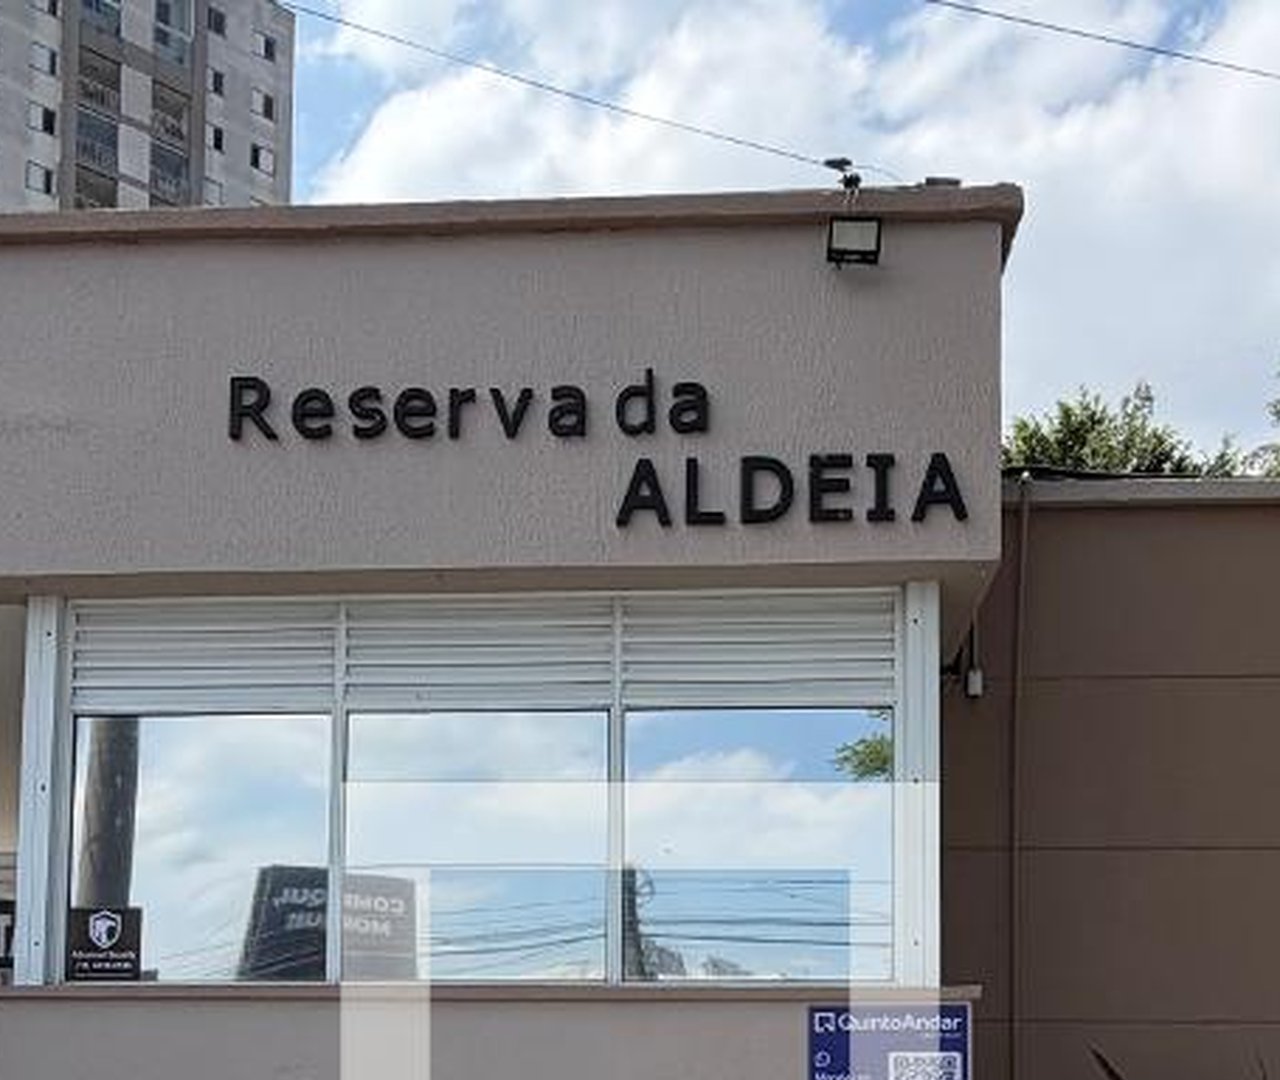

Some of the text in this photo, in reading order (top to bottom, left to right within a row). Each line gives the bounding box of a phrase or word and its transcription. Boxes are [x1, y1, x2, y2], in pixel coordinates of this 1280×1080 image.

[228, 368, 712, 441] Reserva da
[616, 453, 969, 527] ALDEIA
[837, 1013, 963, 1031] QuintoAndar
